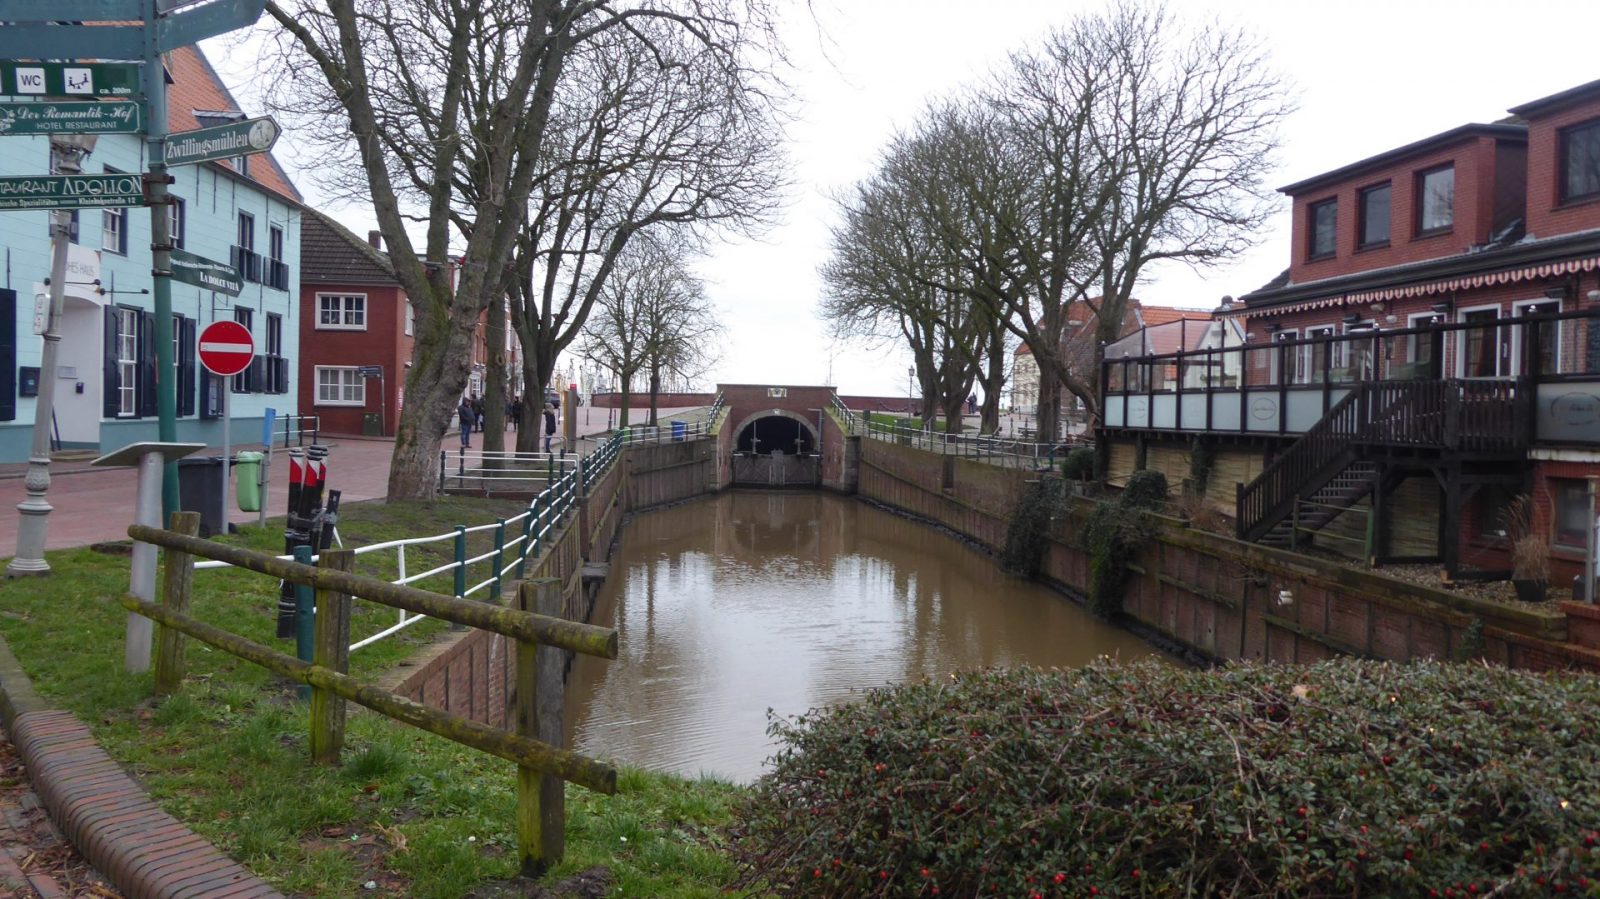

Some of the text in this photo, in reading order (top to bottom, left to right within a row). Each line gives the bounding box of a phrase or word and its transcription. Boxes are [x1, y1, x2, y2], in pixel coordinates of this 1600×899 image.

[21, 75, 41, 86] WC
[17, 105, 39, 119] Der
[36, 121, 117, 130] HOTEL RESTAURANT
[167, 131, 248, 159] Zwillingsmühlen
[62, 175, 143, 195] APOLLON
